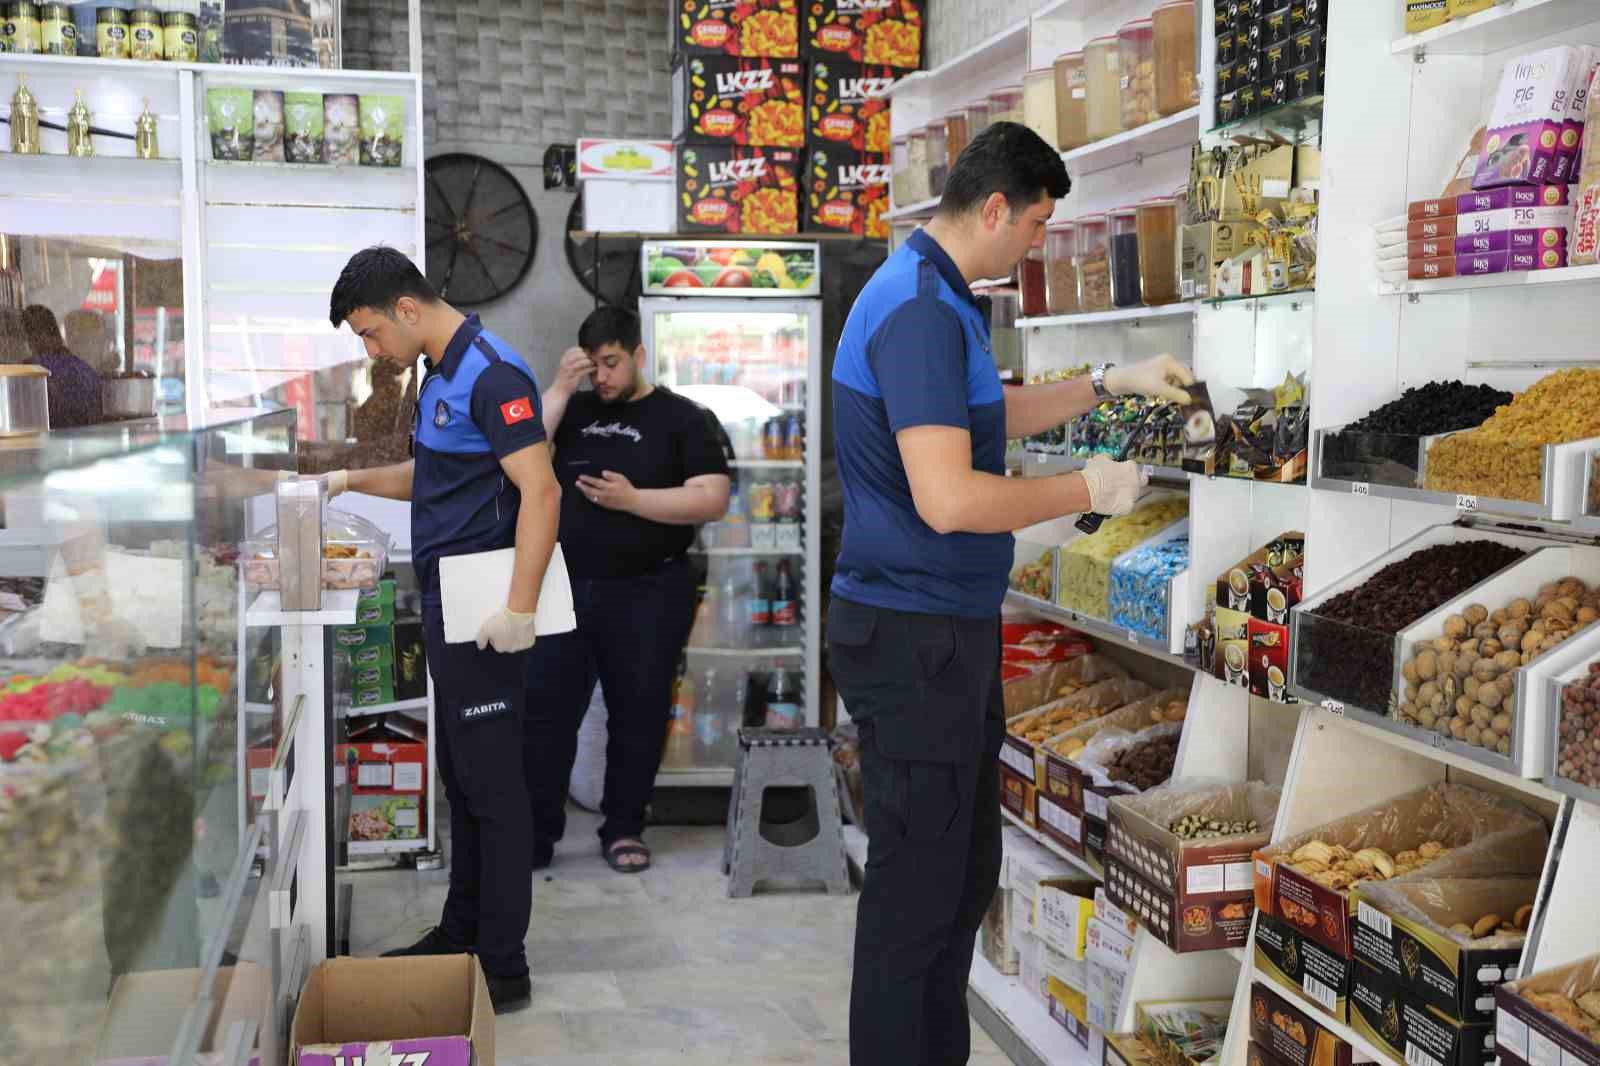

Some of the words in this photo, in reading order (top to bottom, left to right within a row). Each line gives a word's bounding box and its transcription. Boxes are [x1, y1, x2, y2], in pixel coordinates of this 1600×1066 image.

[715, 68, 774, 93] LKZZ
[1513, 86, 1535, 104] FIG
[1551, 90, 1566, 112] FIG
[1572, 89, 1586, 112] FIG
[707, 156, 767, 182] LKZZ
[1514, 208, 1535, 220] FIG
[464, 701, 506, 717] ZABITA
